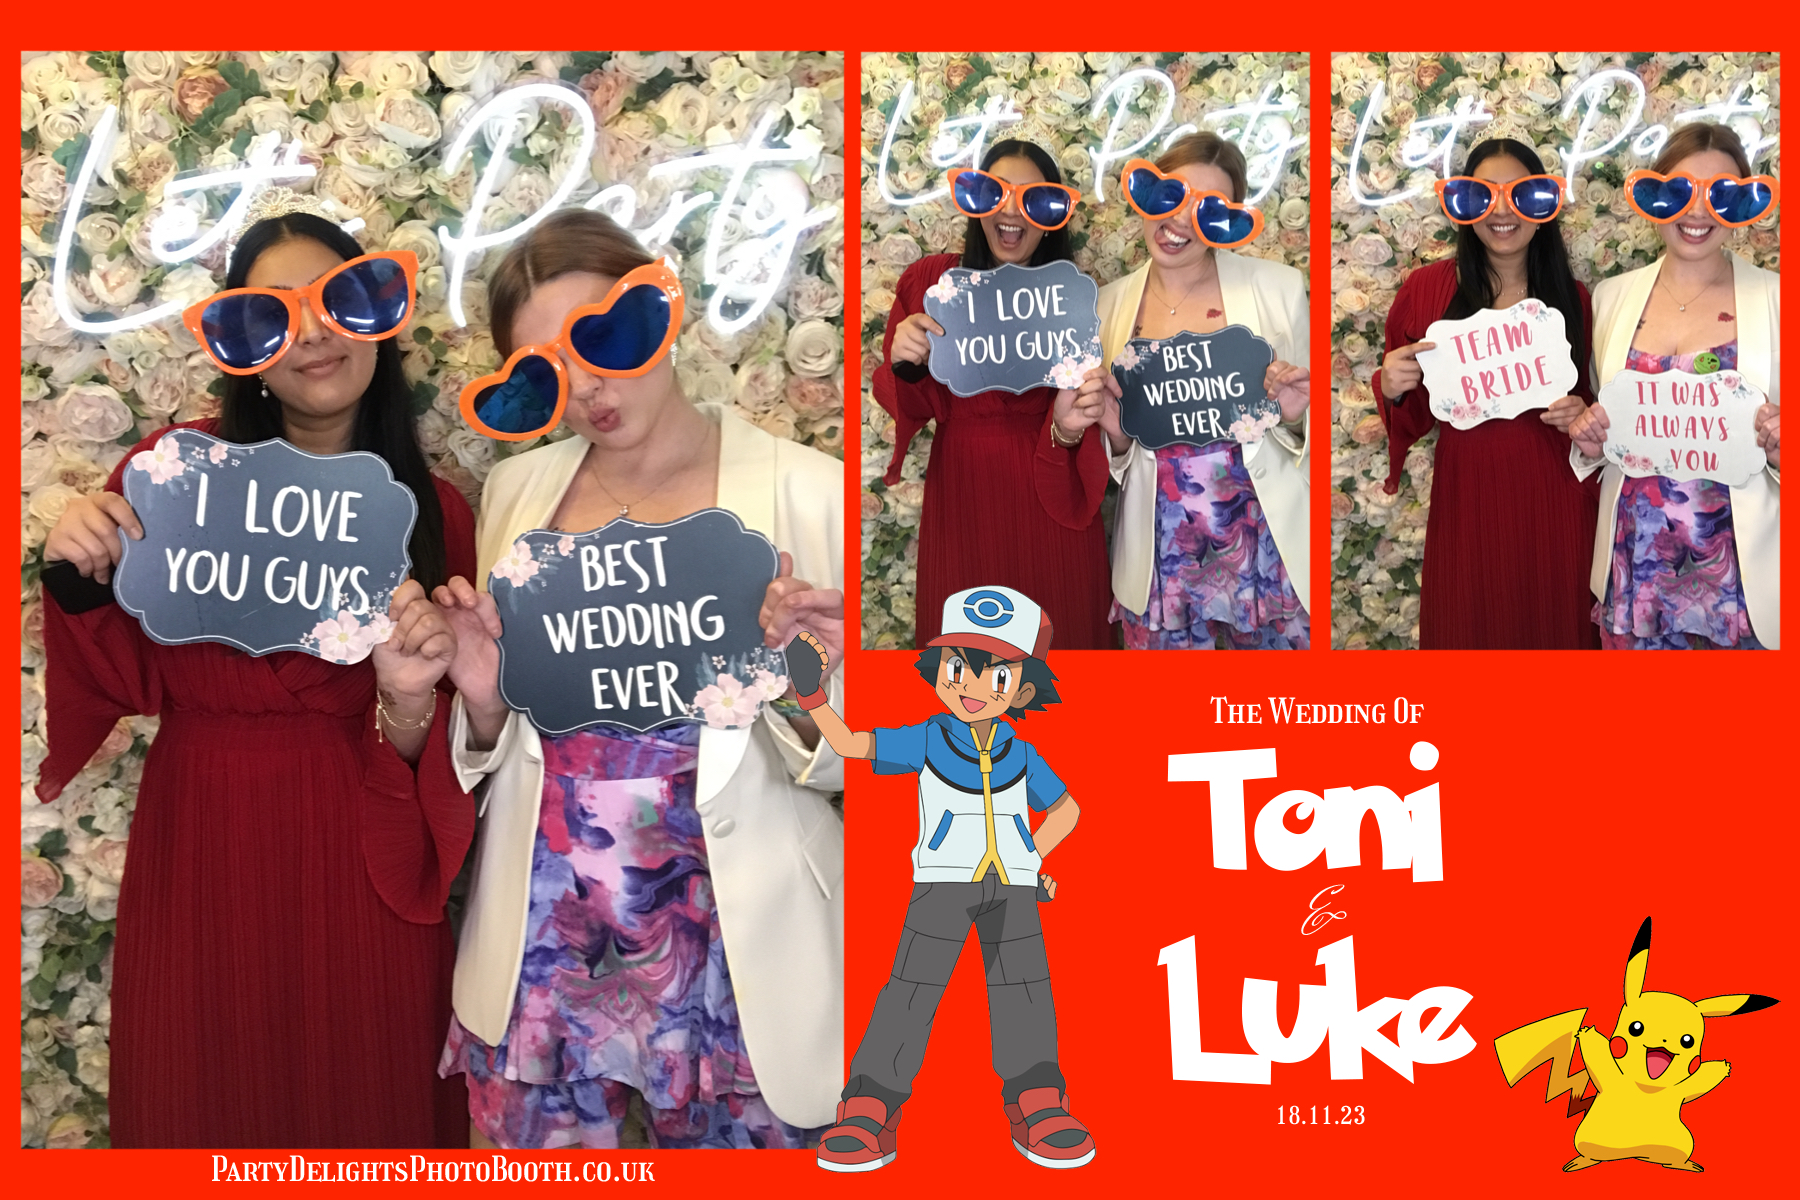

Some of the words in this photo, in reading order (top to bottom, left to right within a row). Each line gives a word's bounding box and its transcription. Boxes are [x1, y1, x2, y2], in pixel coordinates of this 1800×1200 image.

[967, 290, 976, 324] I
[997, 284, 1068, 322] LOVE
[955, 334, 1007, 366] YOU
[1016, 328, 1082, 360] GUYS
[1163, 341, 1212, 373] BEST
[1450, 321, 1533, 364] TEAM
[1143, 372, 1246, 407] WEDDING
[1460, 355, 1552, 405] BRIDE
[1635, 381, 1660, 405] IT
[1670, 381, 1721, 407] WAS
[1172, 408, 1226, 438] EVER
[1634, 415, 1729, 442] ALWAYS
[1670, 448, 1719, 472] YOU
[195, 473, 209, 527] I
[246, 480, 363, 543] LOVE
[165, 548, 249, 602] YOU
[265, 557, 370, 616] GUYS
[580, 536, 668, 593] BEST
[543, 595, 725, 653] WEDDING
[592, 661, 687, 716] EVER
